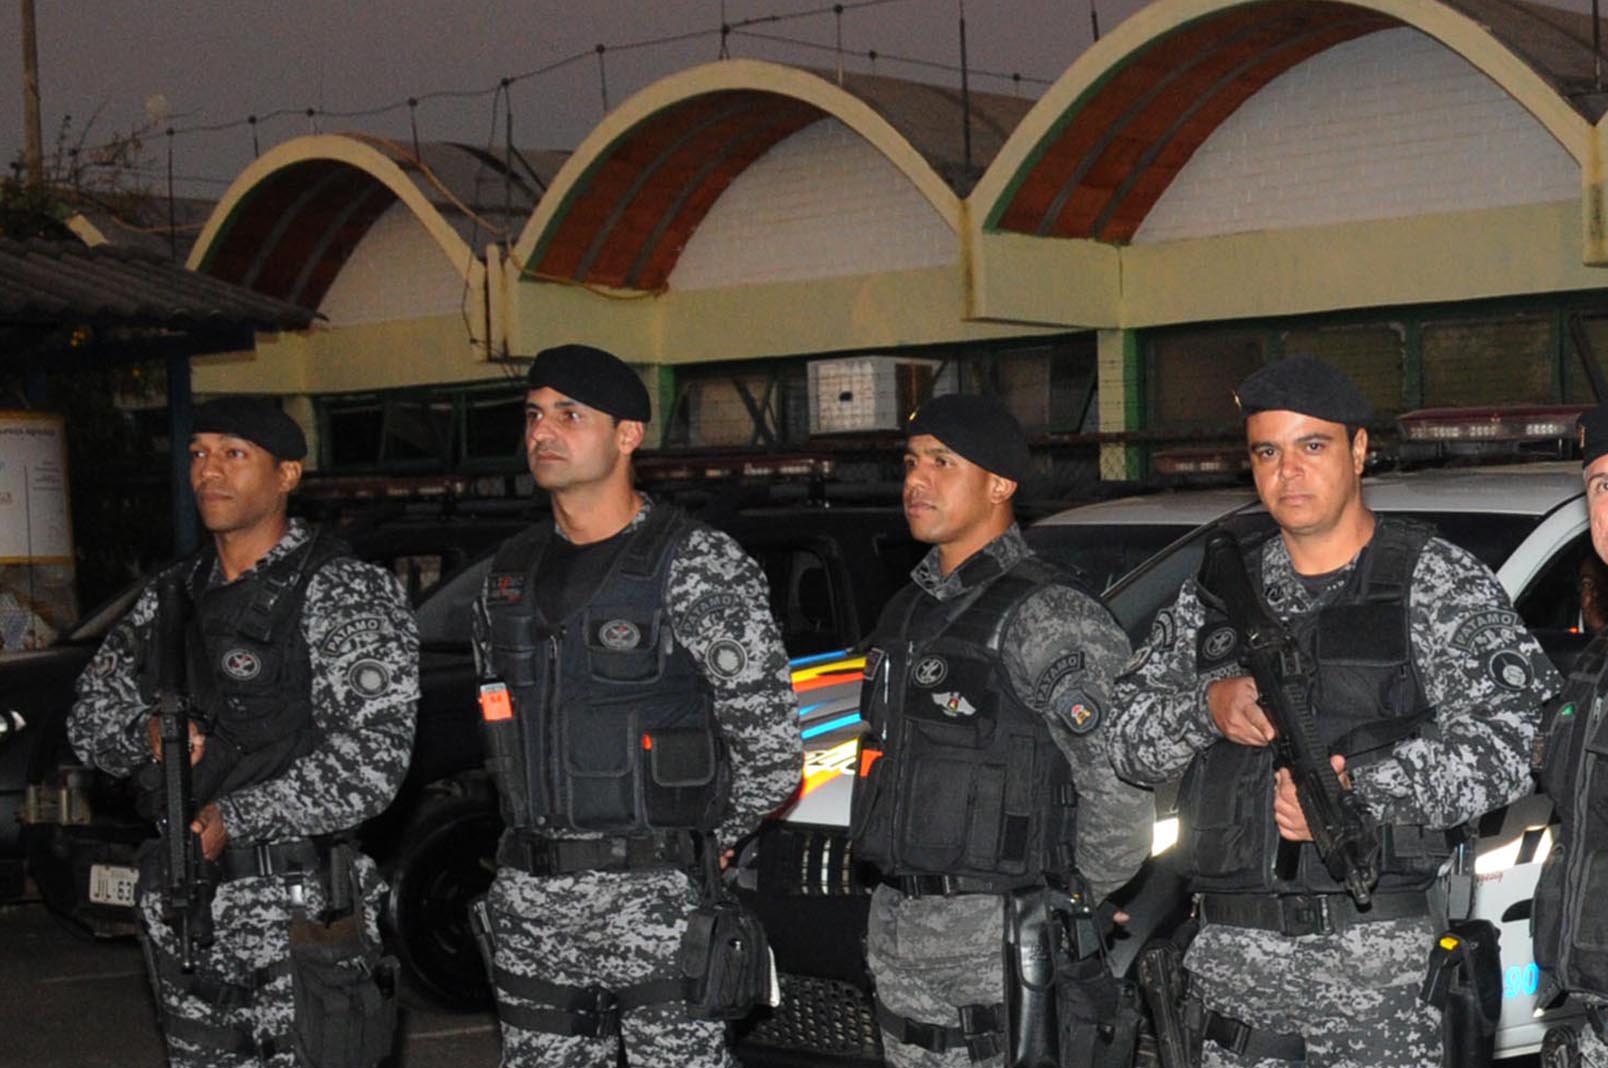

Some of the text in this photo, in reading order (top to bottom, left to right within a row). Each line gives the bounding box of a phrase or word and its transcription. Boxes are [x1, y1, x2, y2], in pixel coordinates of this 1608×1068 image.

[326, 619, 379, 651] PATAMO
[1456, 613, 1511, 645] PATAMO
[1037, 655, 1077, 701] PATAMO
[117, 880, 133, 901] 63
